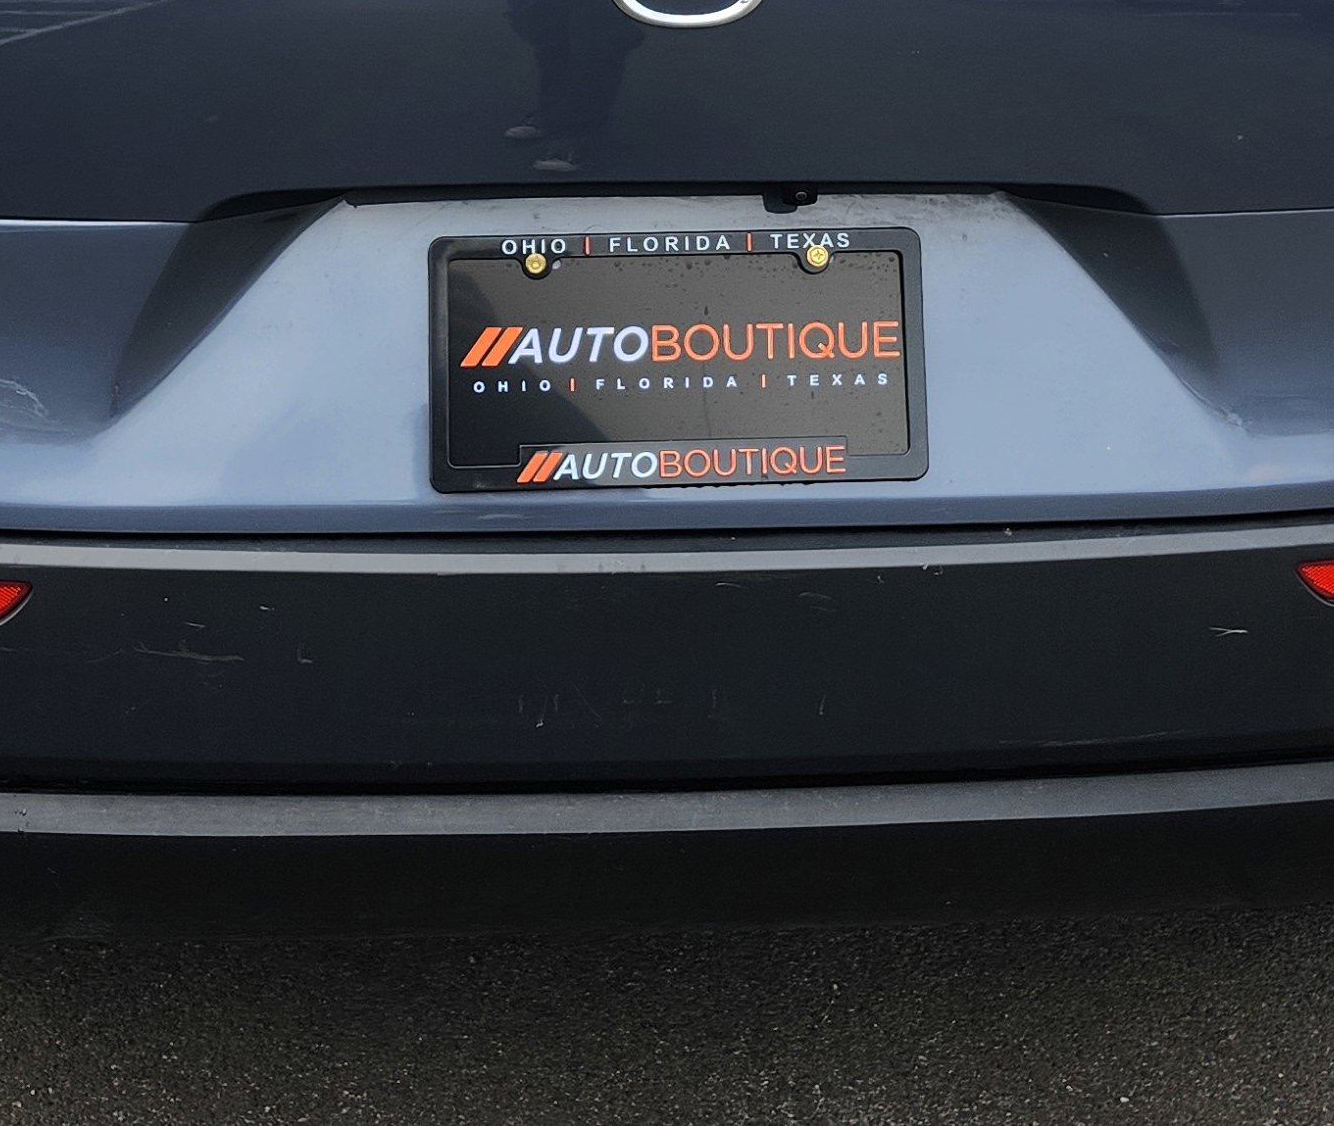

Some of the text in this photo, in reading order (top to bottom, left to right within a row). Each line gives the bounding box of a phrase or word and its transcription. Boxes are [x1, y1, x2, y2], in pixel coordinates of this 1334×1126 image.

[501, 232, 851, 255] OHIO FLORIDA TEXAS
[508, 321, 901, 365] AUTOBOUTIQUE
[473, 373, 889, 394] OHIO FLORIDA TEXAS
[553, 445, 847, 481] AUTOBOUTIQUE
